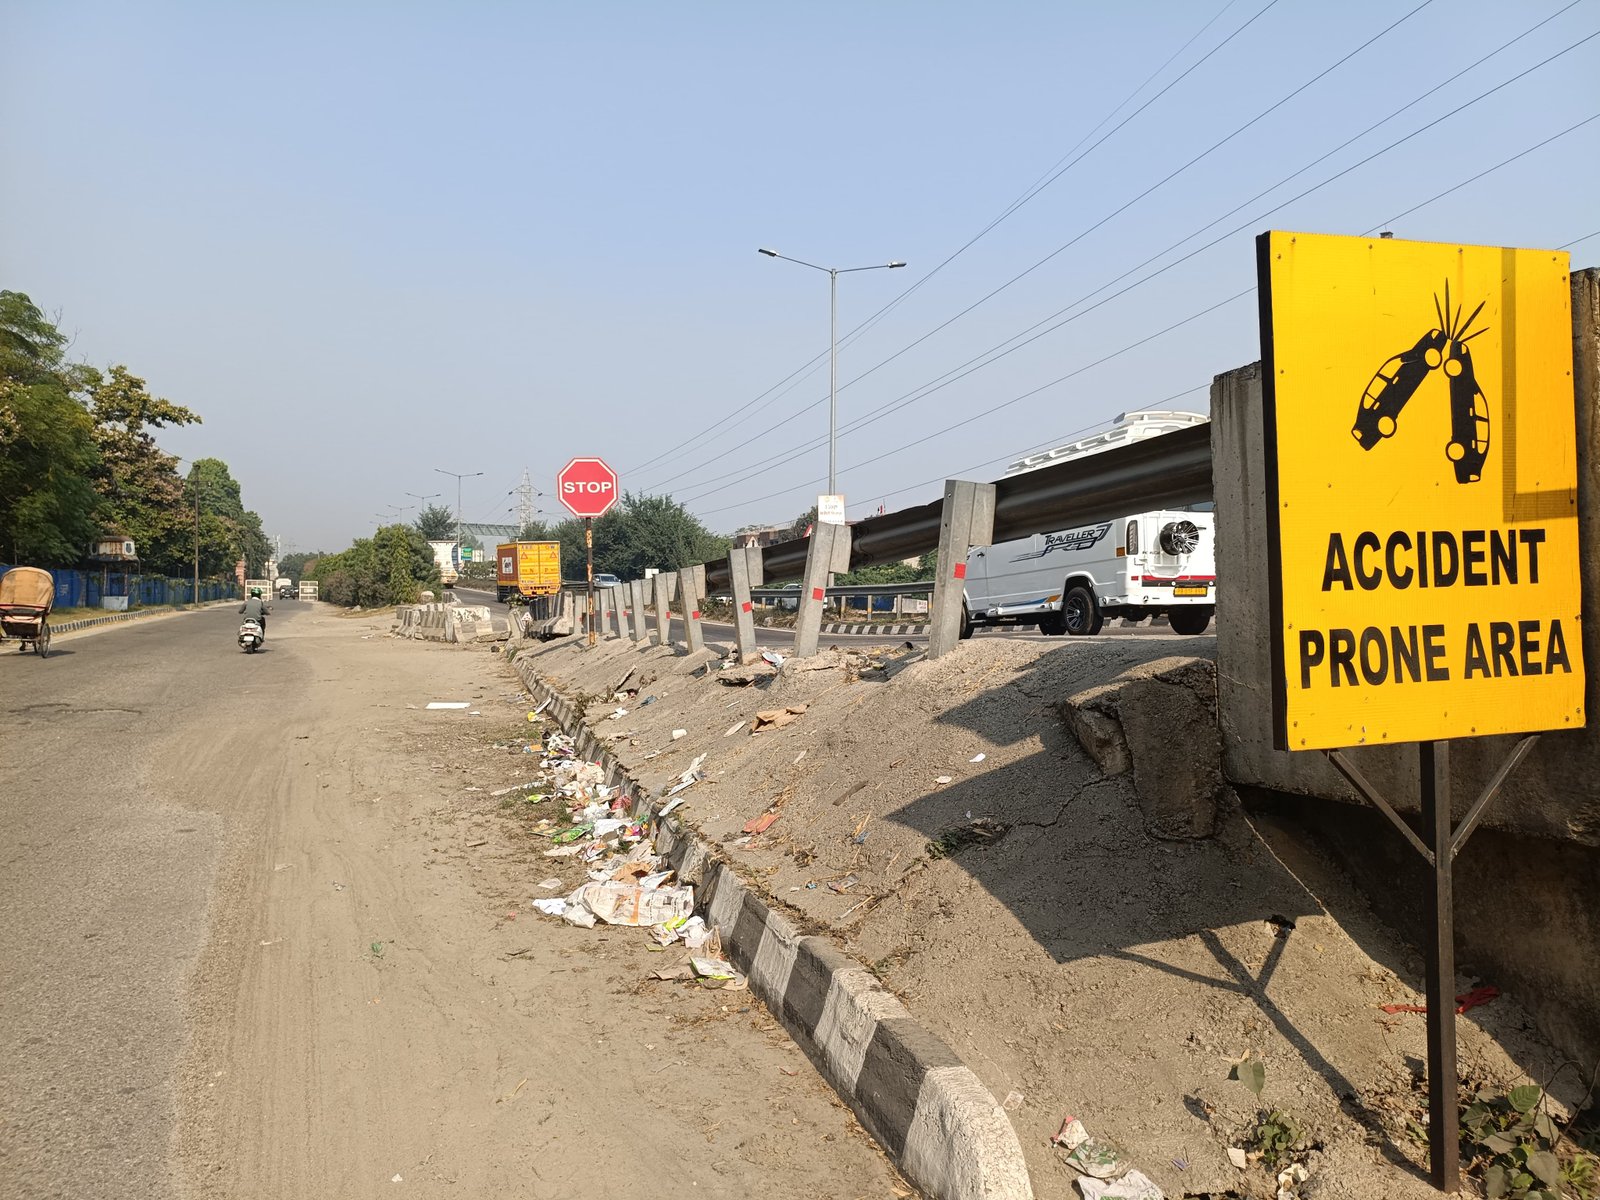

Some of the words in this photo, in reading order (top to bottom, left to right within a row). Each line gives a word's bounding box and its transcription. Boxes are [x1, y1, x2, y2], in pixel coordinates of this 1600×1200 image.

[563, 481, 612, 493] STOP
[1045, 529, 1095, 545] TRAVELLER
[1321, 528, 1546, 592] ACCIDENT
[1299, 624, 1450, 689] PRONE
[1464, 619, 1572, 679] AREA
